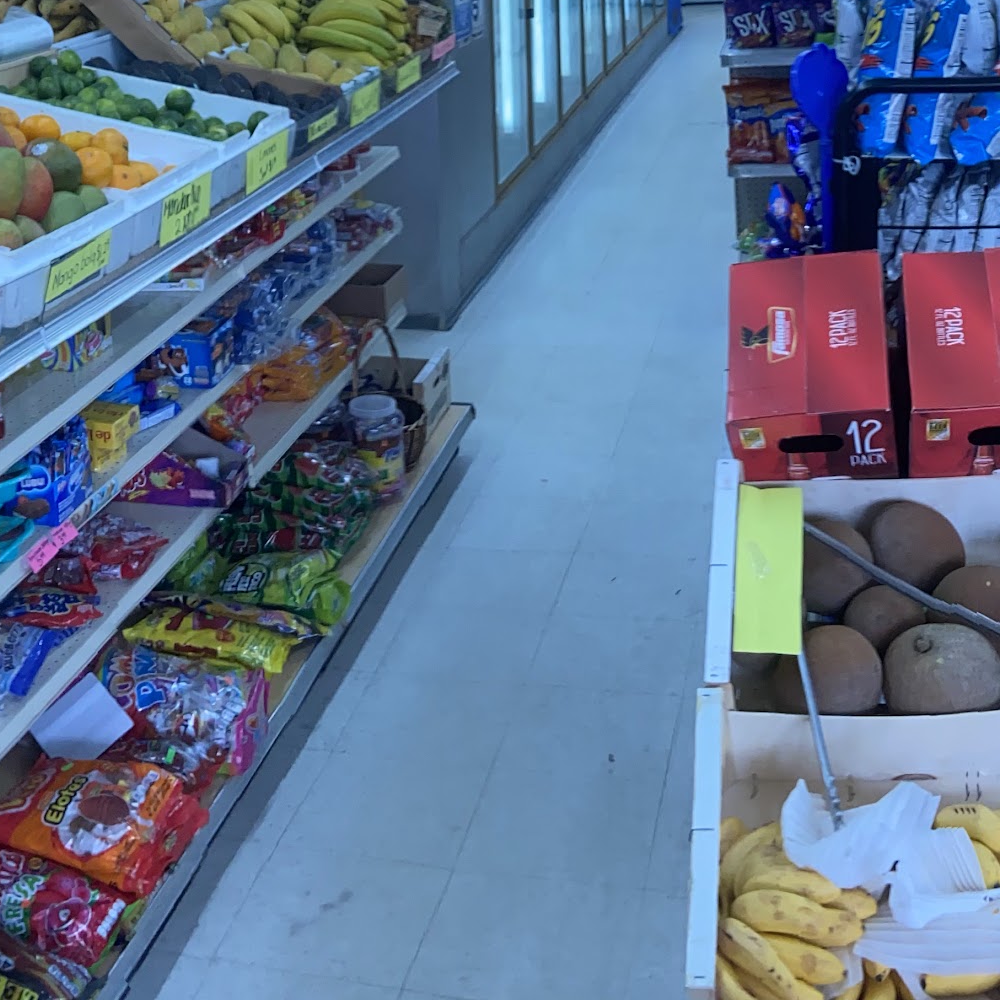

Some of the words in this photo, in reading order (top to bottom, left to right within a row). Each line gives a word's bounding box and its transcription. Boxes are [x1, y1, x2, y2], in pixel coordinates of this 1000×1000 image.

[828, 309, 848, 338] PACK
[945, 319, 966, 346] PACK
[846, 418, 886, 454] 12
[850, 453, 887, 467] PACK
